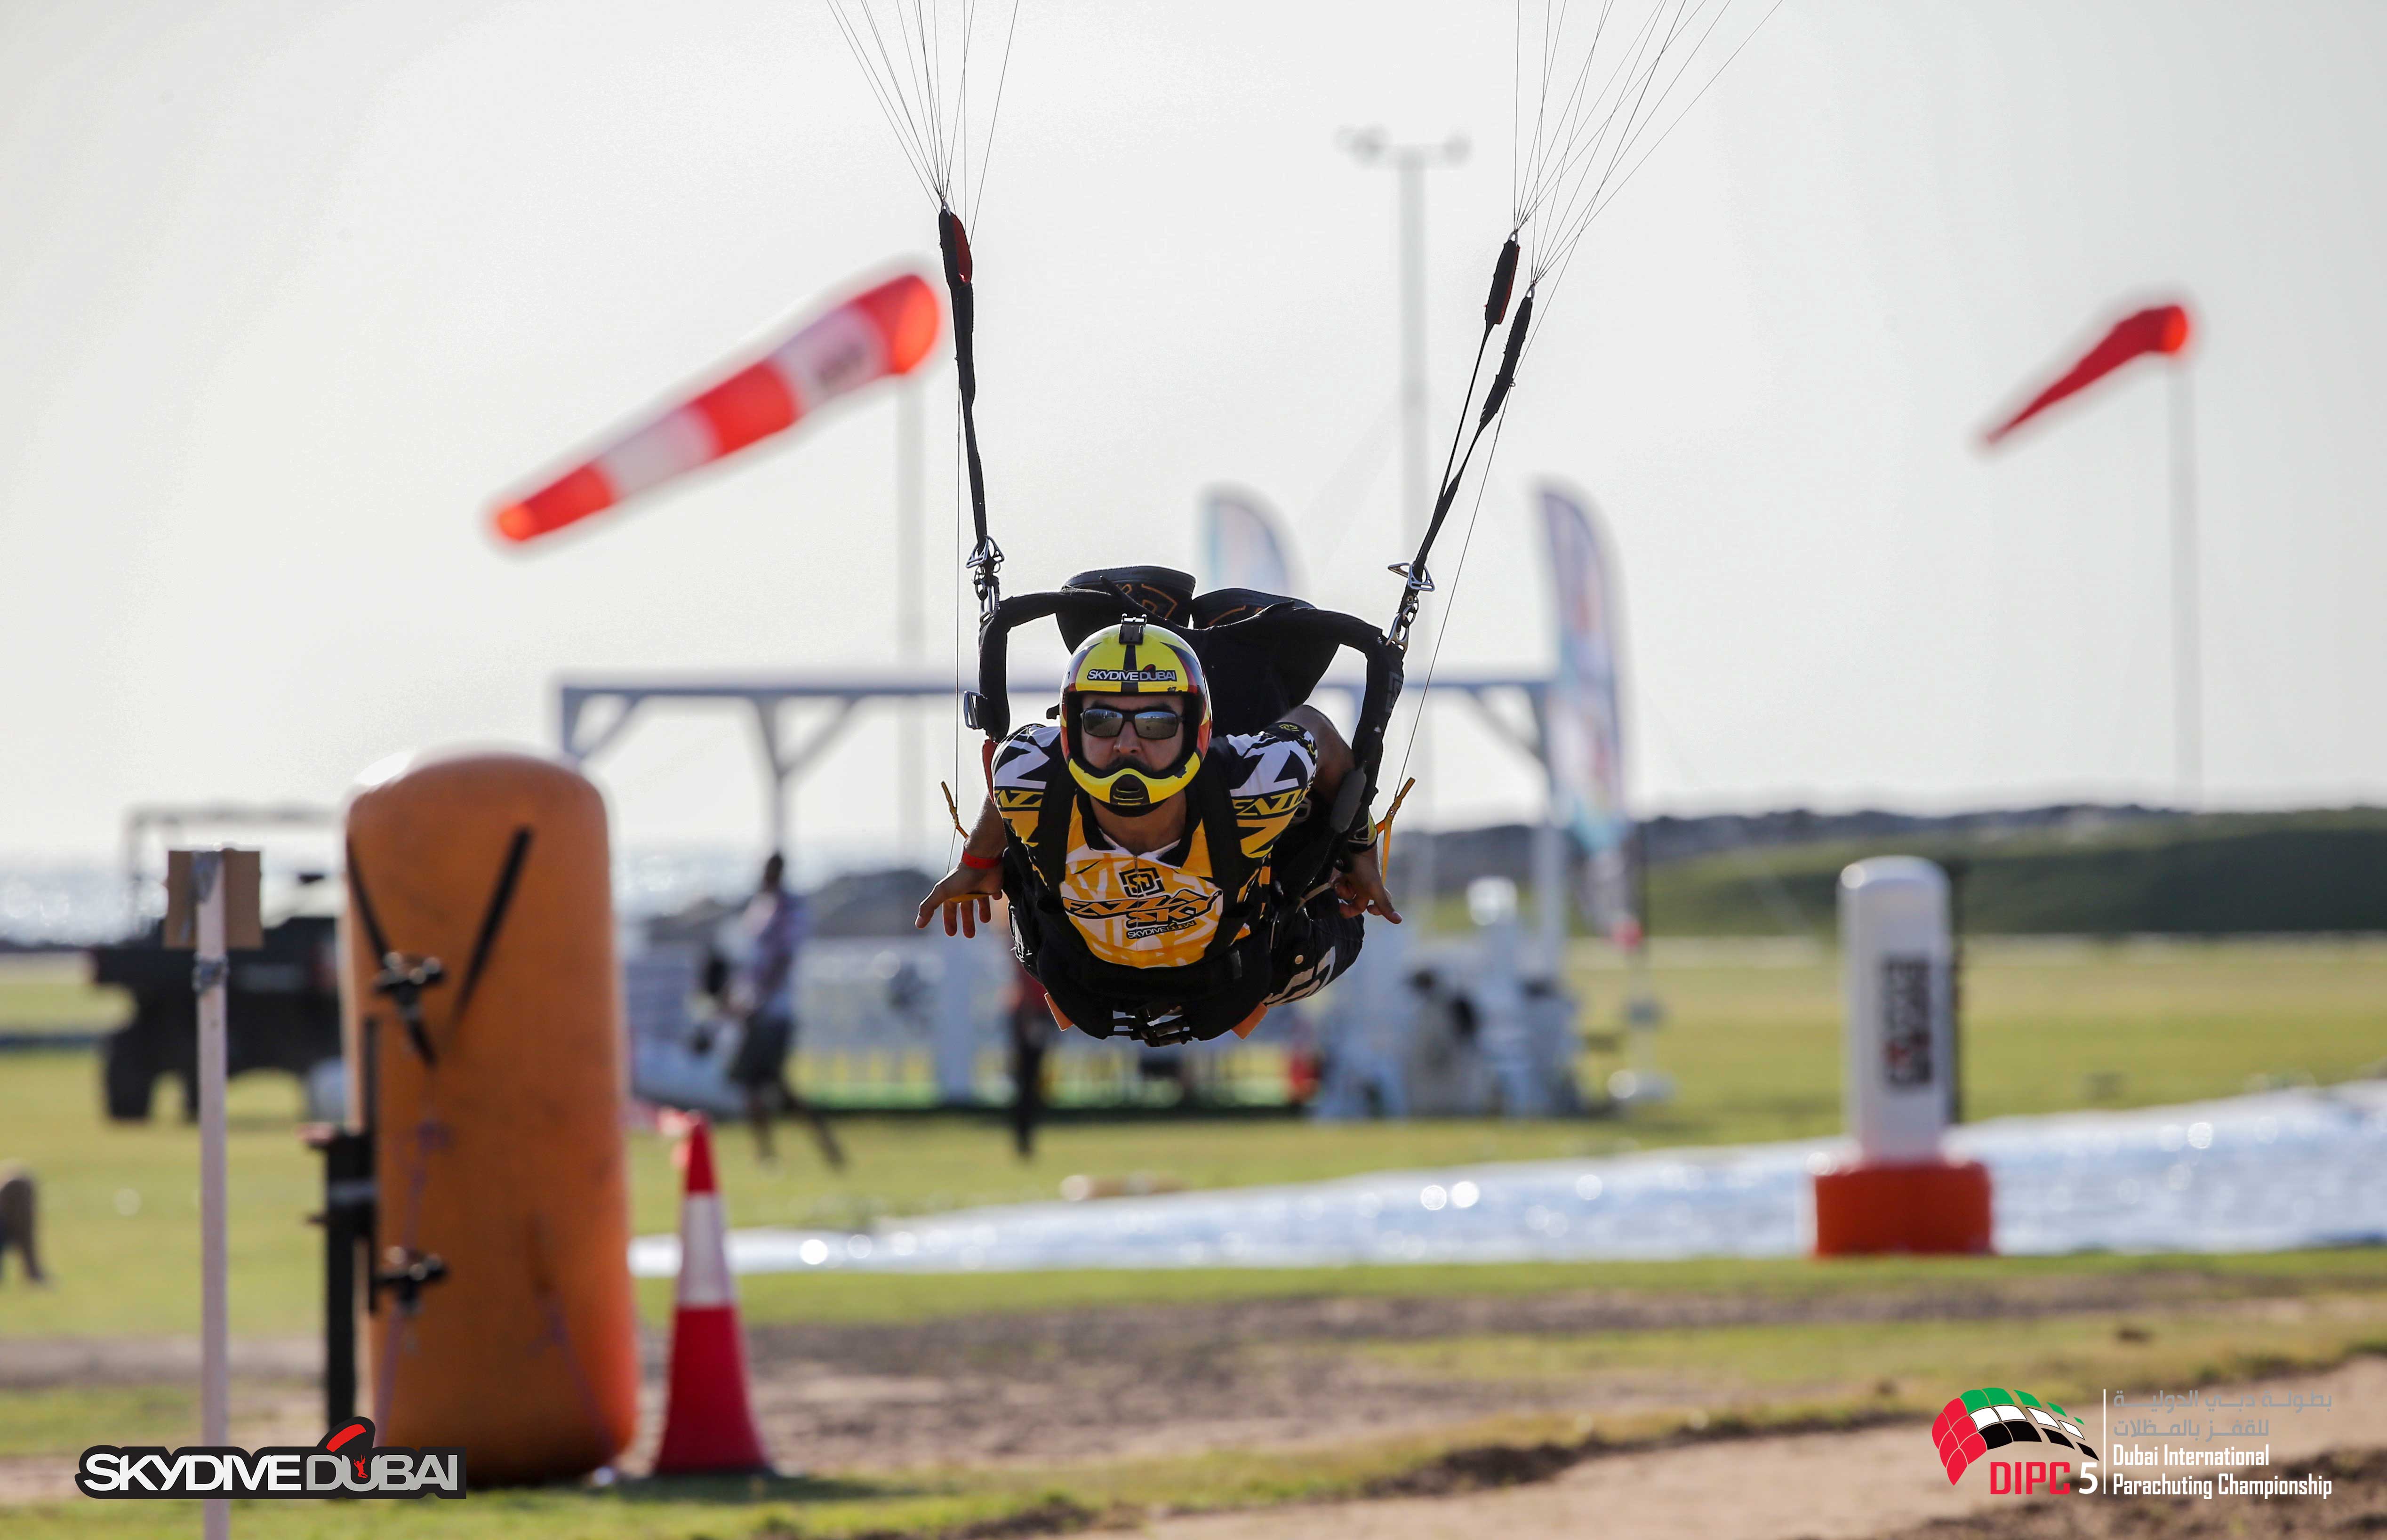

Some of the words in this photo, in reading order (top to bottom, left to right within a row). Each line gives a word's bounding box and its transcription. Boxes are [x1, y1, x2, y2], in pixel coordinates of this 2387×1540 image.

[1088, 671, 1139, 681] SKYDIVE
[1139, 671, 1176, 681] DUBAI
[1127, 927, 1167, 939] SKYDIVE
